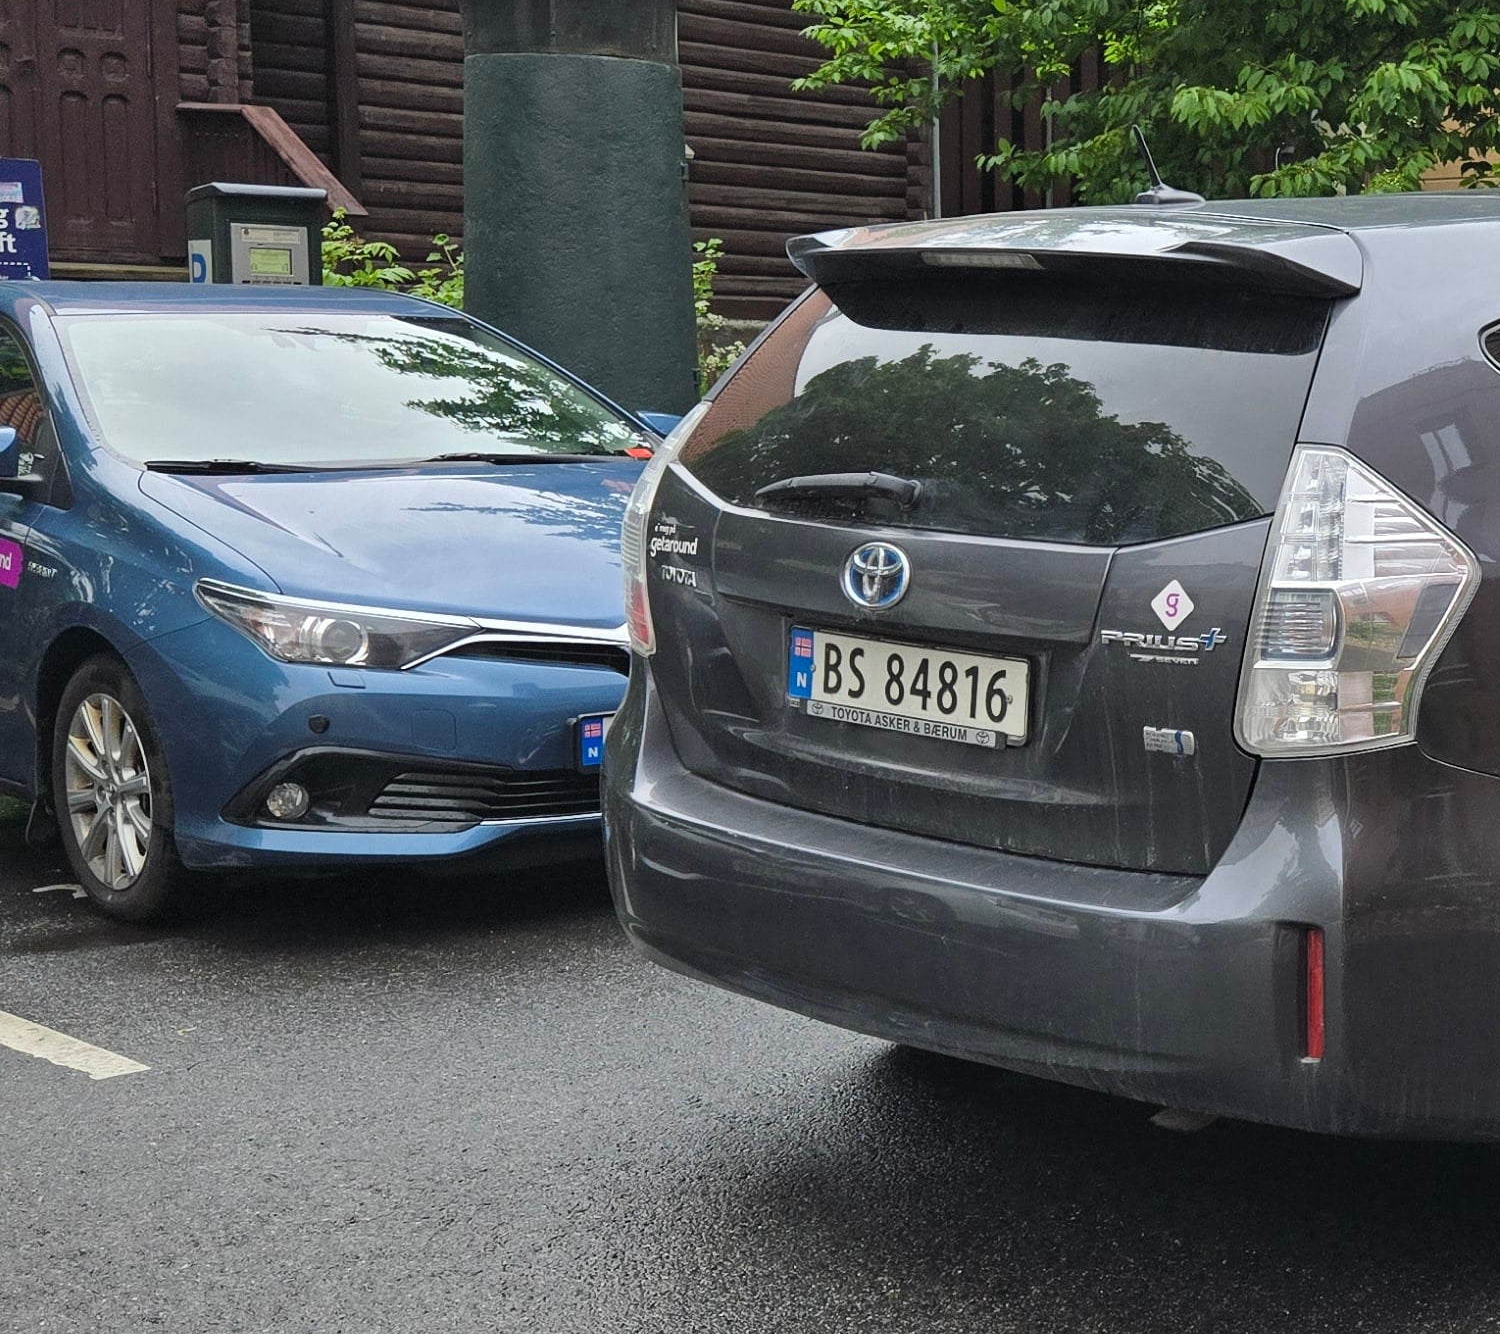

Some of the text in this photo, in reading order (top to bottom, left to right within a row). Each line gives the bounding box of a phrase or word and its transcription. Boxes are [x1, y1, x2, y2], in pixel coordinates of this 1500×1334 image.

[650, 536, 699, 558] getaround
[661, 564, 697, 588] TOYOTA
[1165, 593, 1181, 618] g
[796, 671, 808, 689] N
[823, 642, 1008, 724] BS 84816
[831, 705, 968, 742] TOYOTA ASKER & BÆRUM
[587, 746, 599, 758] N
